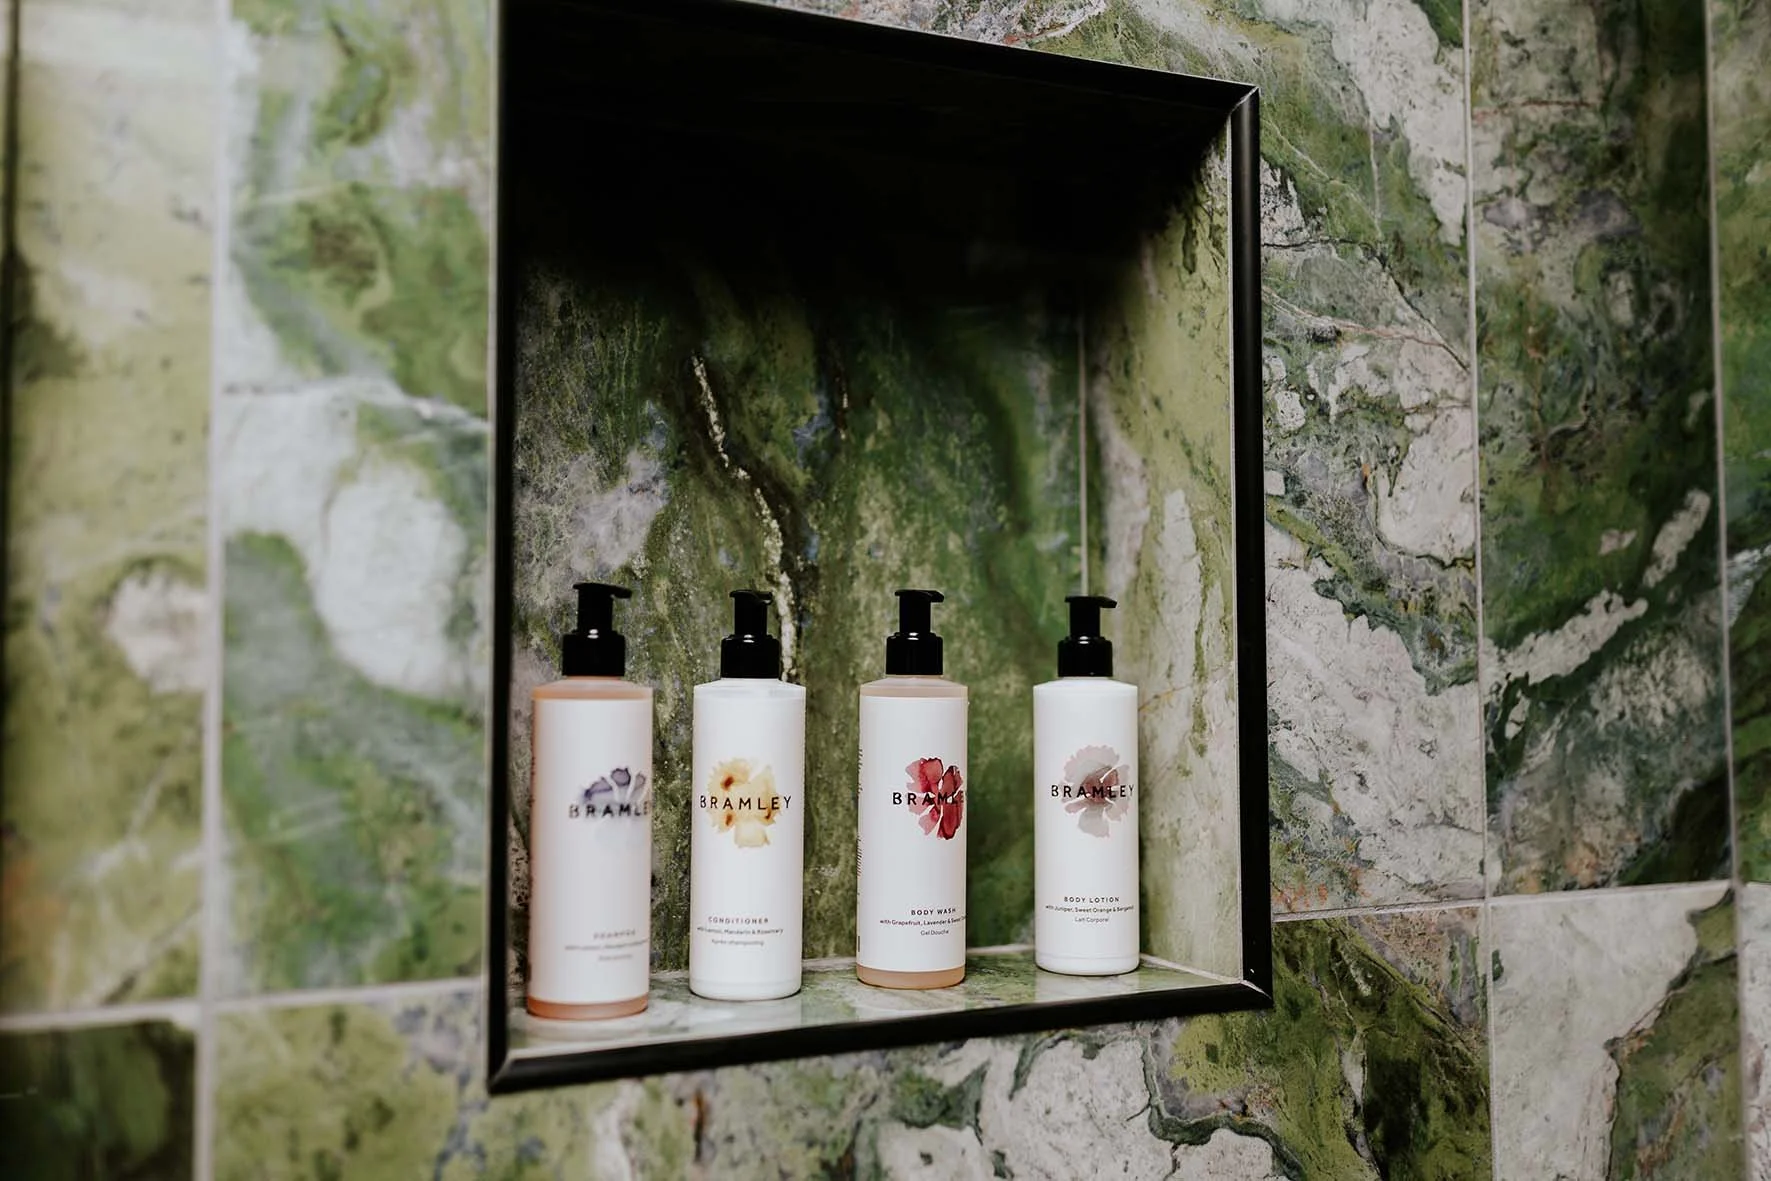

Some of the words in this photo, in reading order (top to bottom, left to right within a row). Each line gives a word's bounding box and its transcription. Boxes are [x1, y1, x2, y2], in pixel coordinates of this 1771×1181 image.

[1051, 784, 1135, 798] BRAMLEY
[699, 795, 792, 810] BRAMLEY
[708, 916, 769, 925] CONDITIONER
